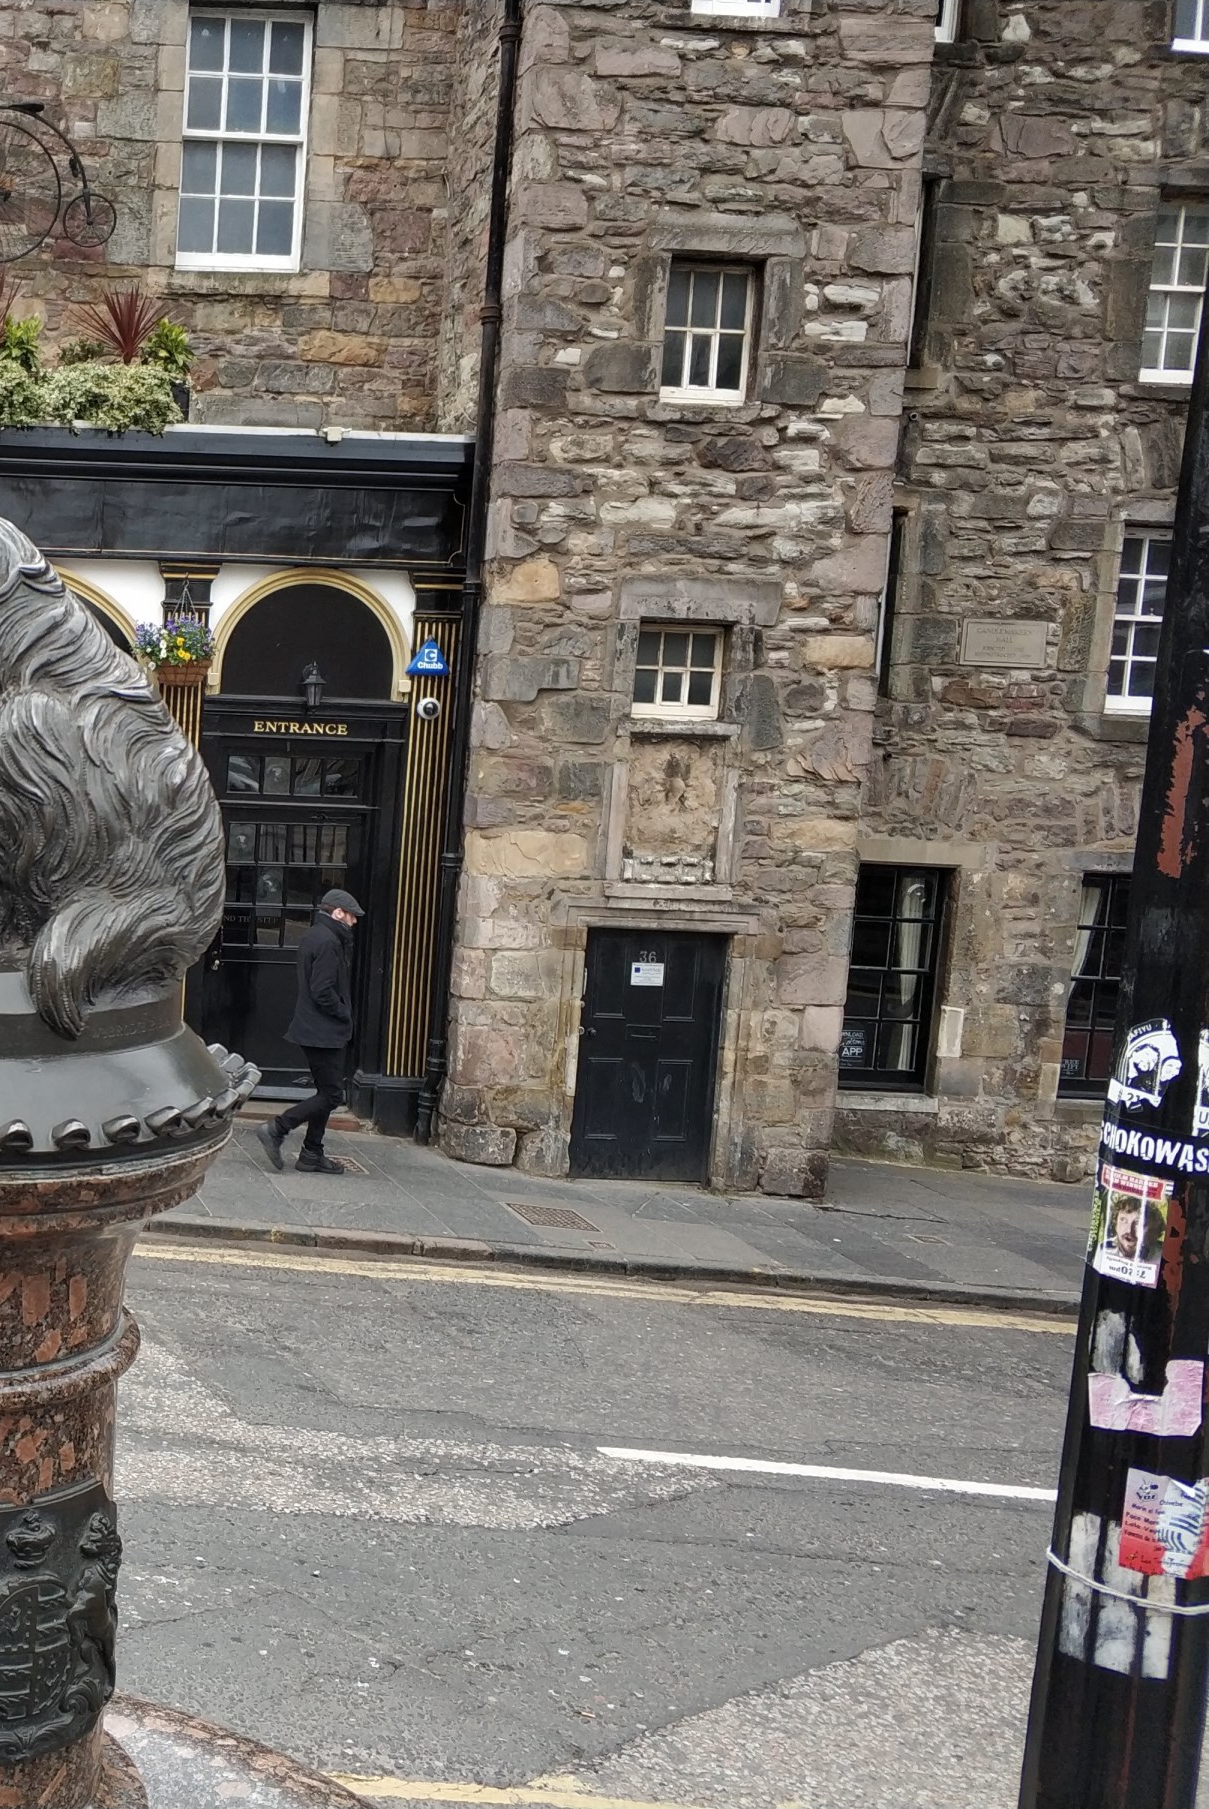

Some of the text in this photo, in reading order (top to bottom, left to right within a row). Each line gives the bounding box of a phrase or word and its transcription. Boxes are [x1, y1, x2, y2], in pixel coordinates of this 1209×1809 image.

[417, 661, 444, 670] Chubb
[253, 720, 348, 736] ENTRANCE
[639, 950, 657, 963] 36
[841, 1047, 863, 1057] APP
